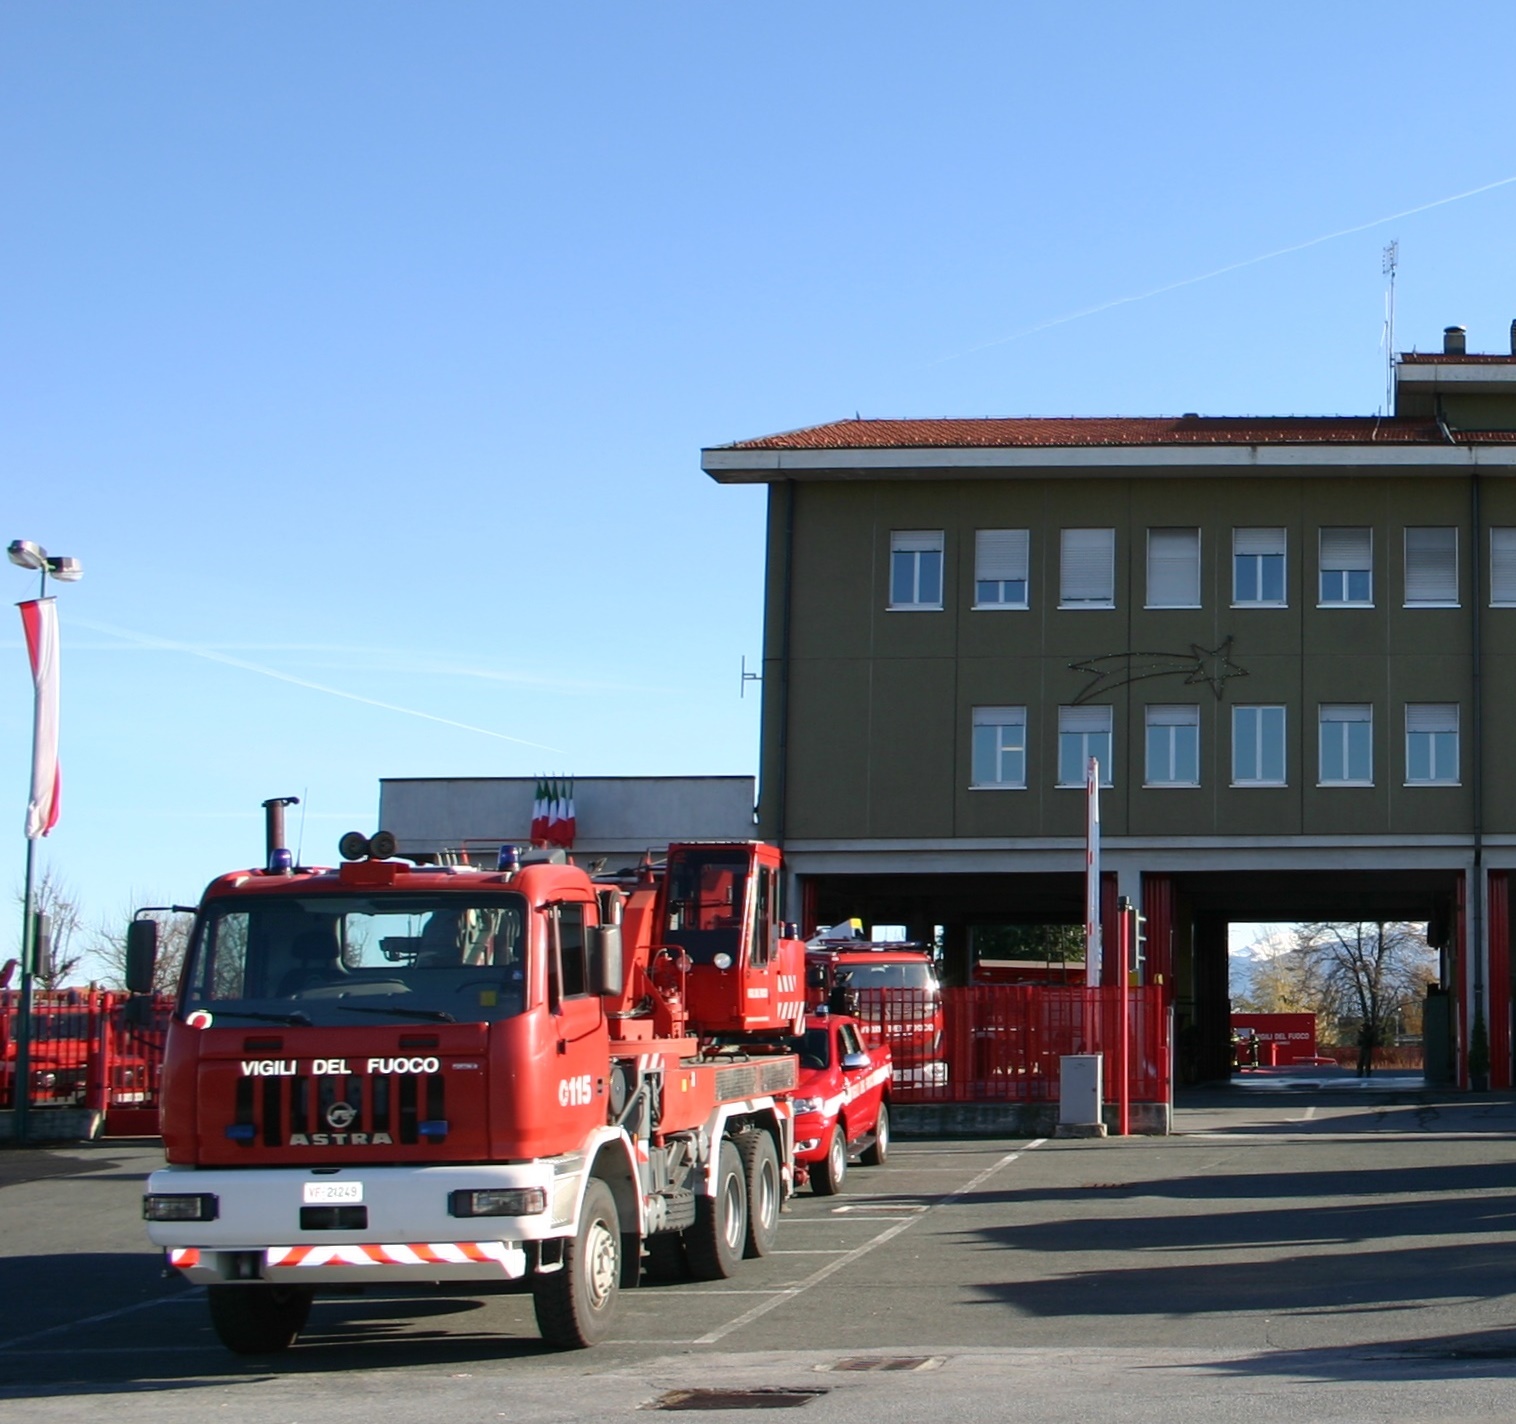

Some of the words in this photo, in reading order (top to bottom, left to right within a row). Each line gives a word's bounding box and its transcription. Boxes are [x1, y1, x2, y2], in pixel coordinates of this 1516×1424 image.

[241, 1060, 297, 1076] VIGILI
[312, 1059, 352, 1075] DEL
[366, 1057, 440, 1074] FUOCO
[569, 1075, 592, 1106] 115
[289, 1133, 393, 1146] ASTRA
